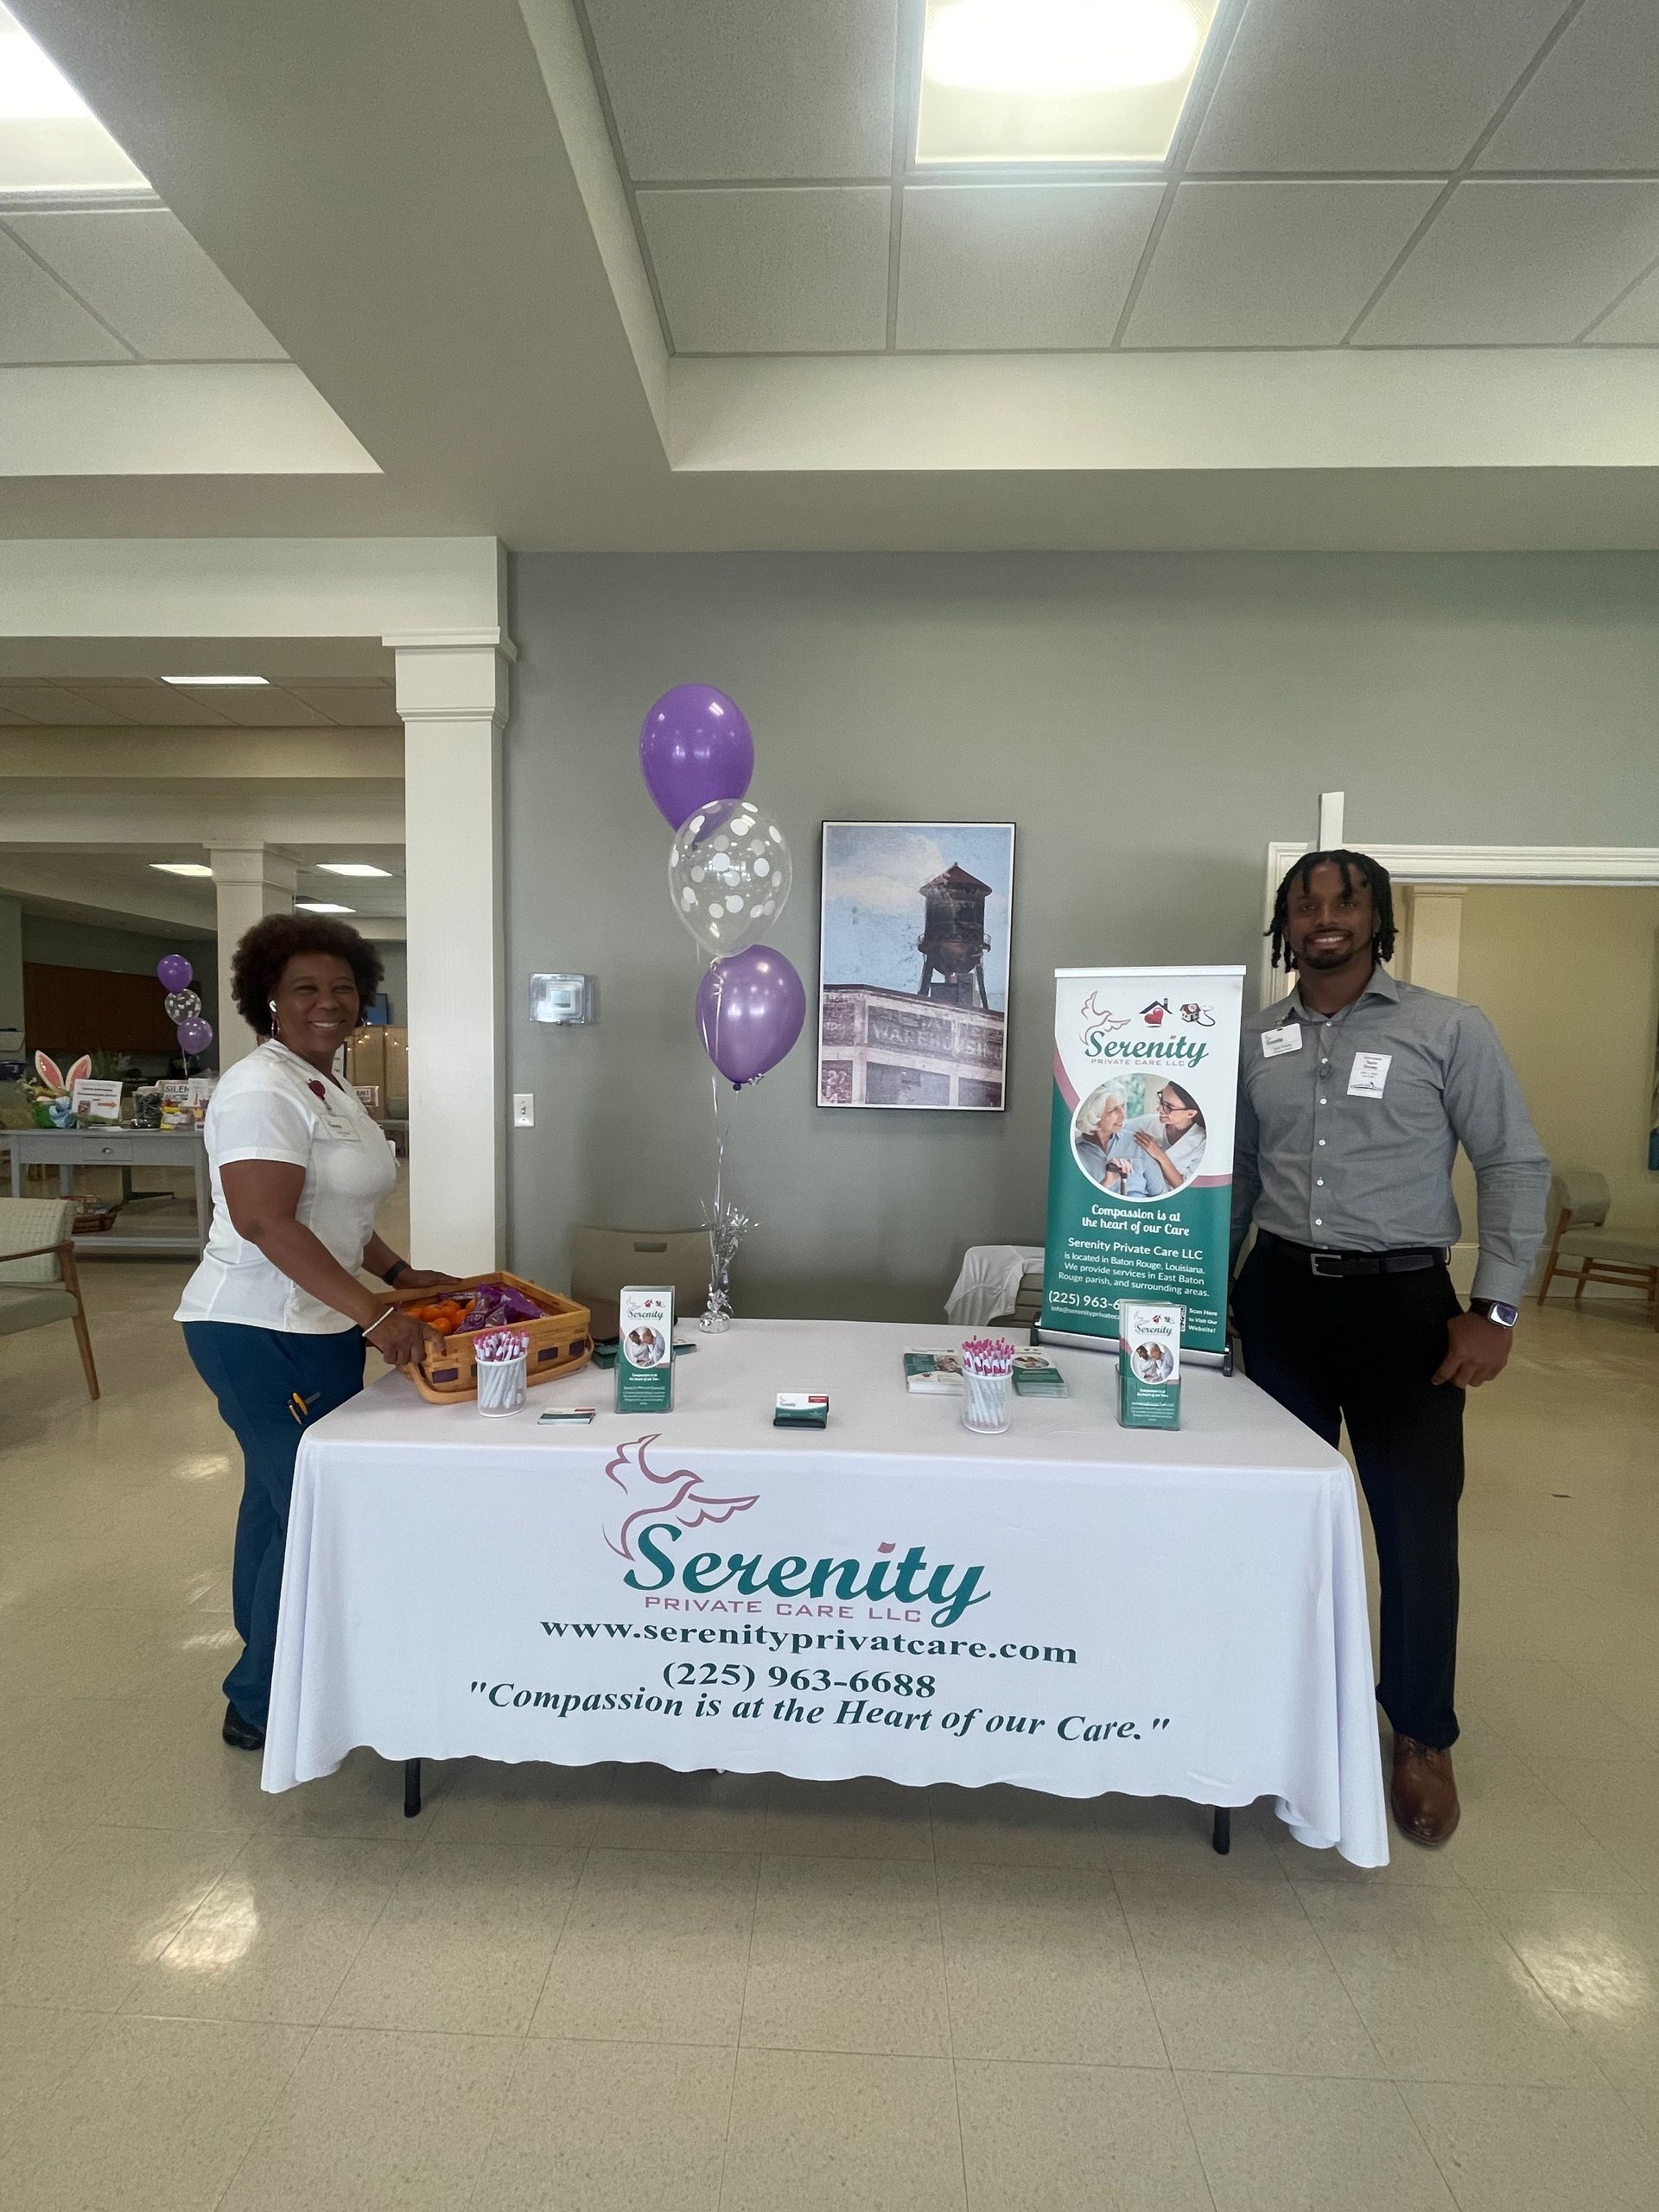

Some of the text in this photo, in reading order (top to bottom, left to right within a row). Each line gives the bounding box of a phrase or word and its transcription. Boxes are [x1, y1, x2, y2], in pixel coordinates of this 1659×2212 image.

[1085, 1031, 1209, 1068] Serenity
[1091, 1204, 1180, 1222] Compassion is at
[1082, 1217, 1097, 1227] the
[1100, 1217, 1128, 1230] heart
[1130, 1220, 1141, 1234] of
[1164, 1224, 1190, 1236] Care
[1068, 1237, 1203, 1260] Serenity Private Care LLC
[1064, 1262, 1078, 1271] We
[1080, 1265, 1110, 1275] provide
[1112, 1269, 1146, 1279] services
[1158, 1272, 1176, 1282] East
[1179, 1274, 1205, 1285] Baton
[1071, 1253, 1100, 1262] located
[1110, 1256, 1134, 1267] Baton
[1136, 1259, 1163, 1270] Rouge,
[1166, 1262, 1205, 1274] Louisiana.
[1058, 1272, 1210, 1297] Rouge parish, and surrounding areas.
[1048, 1289, 1120, 1311] (225) 963-6
[628, 1310, 664, 1320] Serenity
[1051, 1305, 1120, 1320] info@serenityprivatec
[1135, 1324, 1173, 1336] Serenity
[1188, 1325, 1216, 1334] Website!
[623, 1522, 991, 1628] Serenity
[645, 1597, 922, 1623] PRIVATE CARE LLC
[538, 1618, 1078, 1664] www.serenityprivatcare.com
[663, 1662, 936, 1698] (225) 963-6688
[469, 1680, 1170, 1742] "Compassion is at the Heart of our Care."
